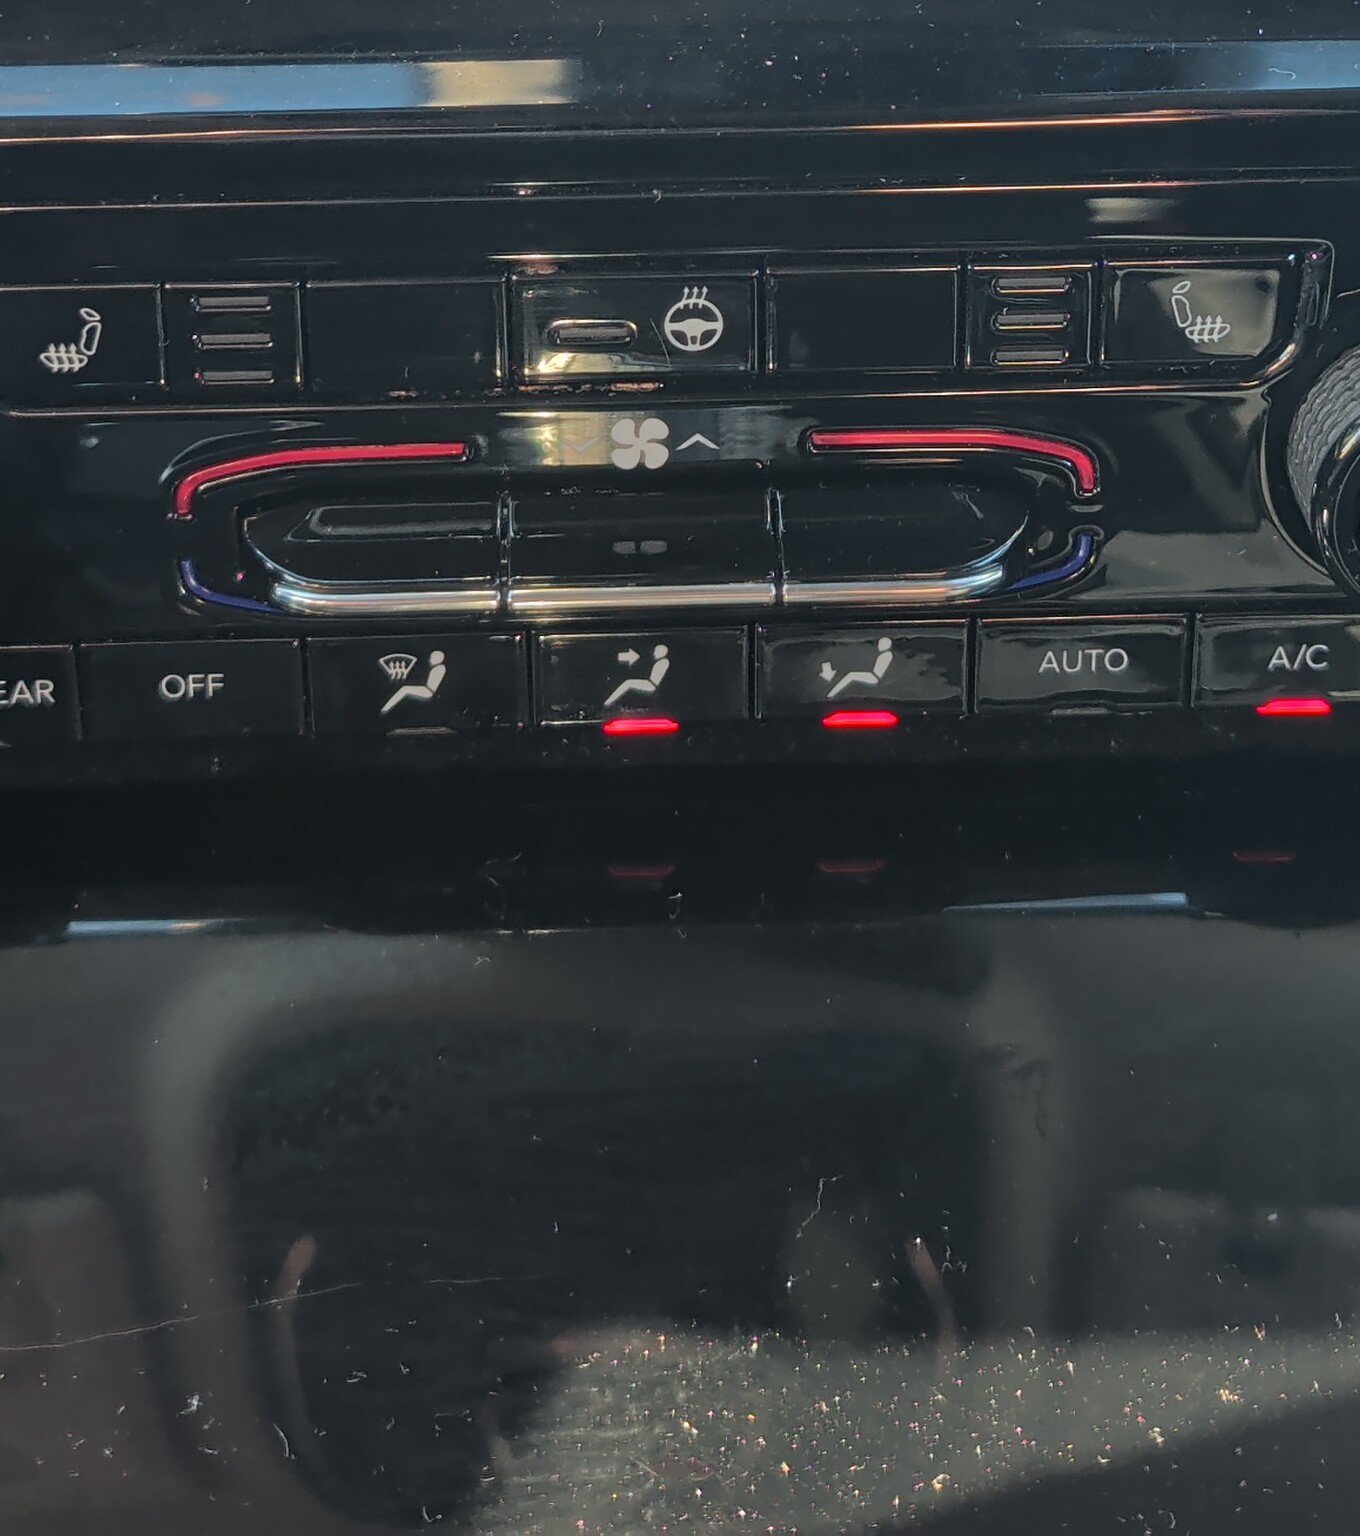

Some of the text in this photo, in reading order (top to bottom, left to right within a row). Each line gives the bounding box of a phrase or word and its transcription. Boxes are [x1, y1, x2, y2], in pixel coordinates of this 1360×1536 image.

[1038, 647, 1129, 674] AUTO
[1267, 643, 1331, 670] A/C
[158, 673, 225, 701] OFF
